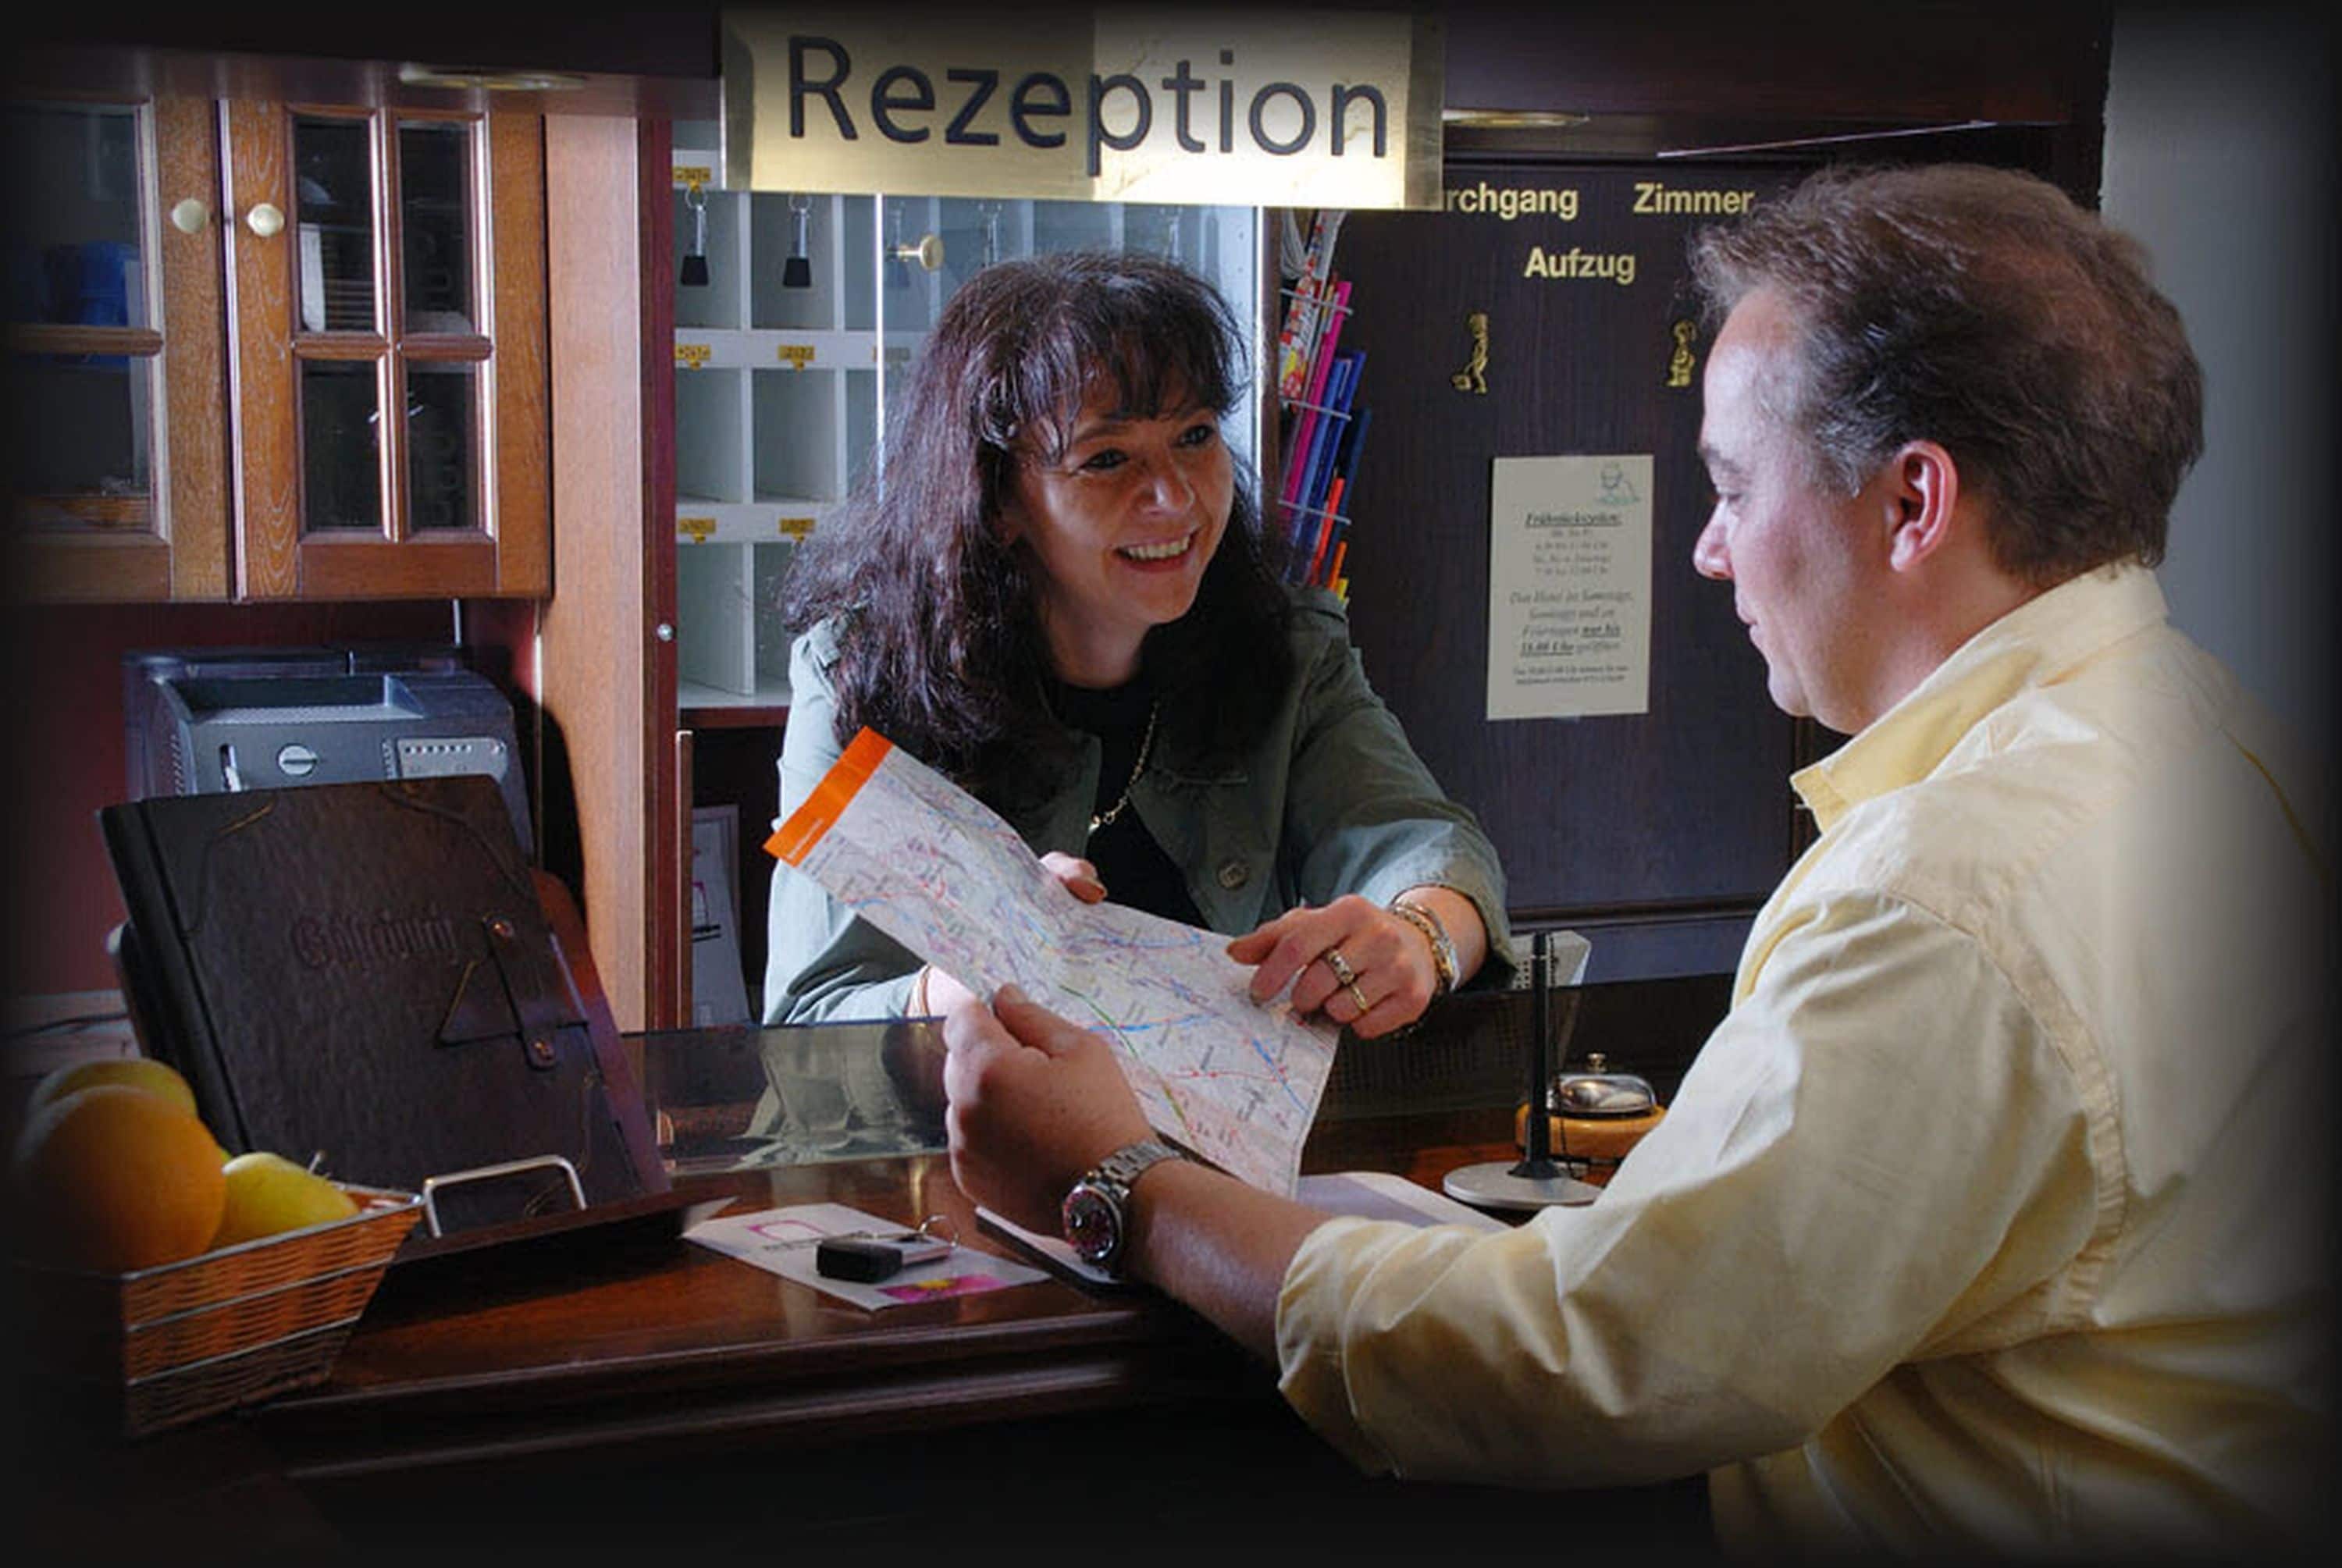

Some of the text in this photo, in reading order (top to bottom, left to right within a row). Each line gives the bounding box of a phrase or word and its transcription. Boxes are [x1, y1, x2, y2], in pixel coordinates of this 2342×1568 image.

[788, 35, 1387, 177] Rezeption
[1446, 181, 1579, 220] rchgang
[1633, 182, 1756, 214] Zimmer
[1524, 247, 1635, 285] Aufzug
